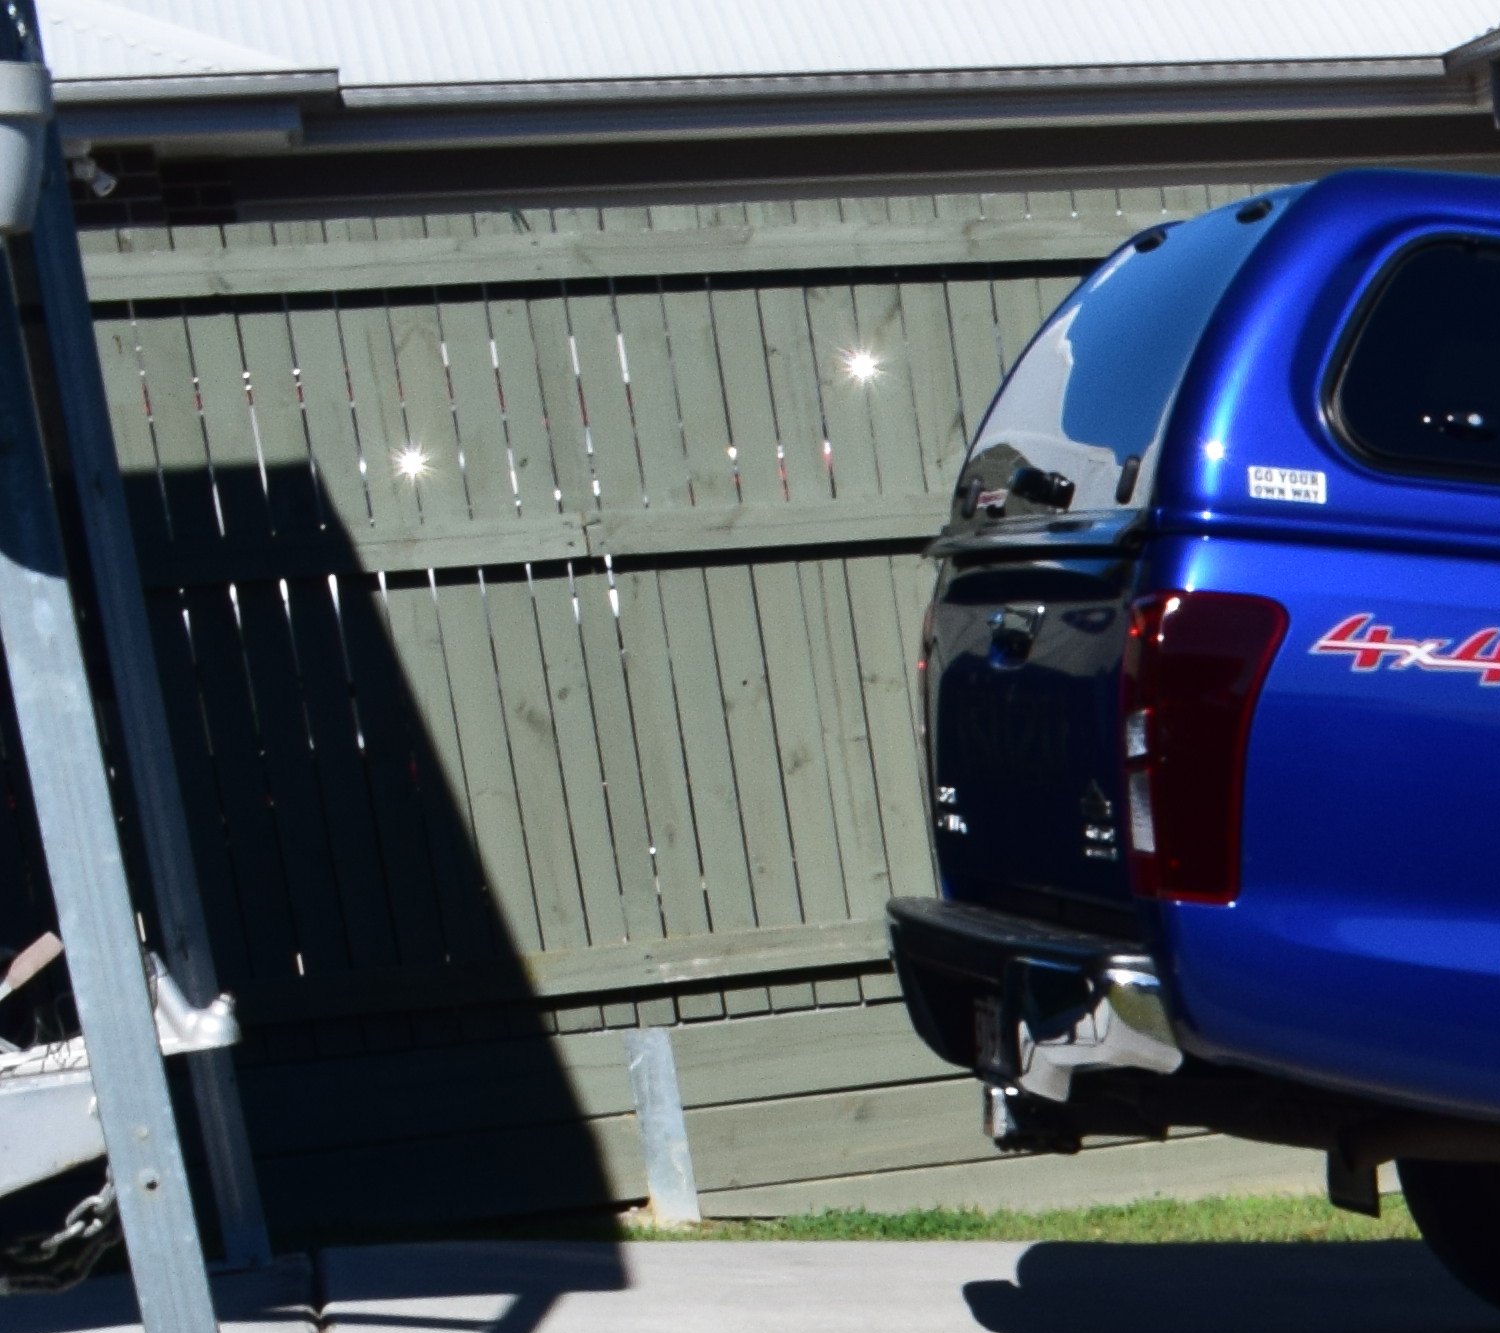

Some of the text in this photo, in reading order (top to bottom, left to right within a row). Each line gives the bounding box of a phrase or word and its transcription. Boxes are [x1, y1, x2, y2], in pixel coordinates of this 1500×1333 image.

[1280, 471, 1319, 486] YOUR
[1254, 485, 1319, 501] OWN WAY
